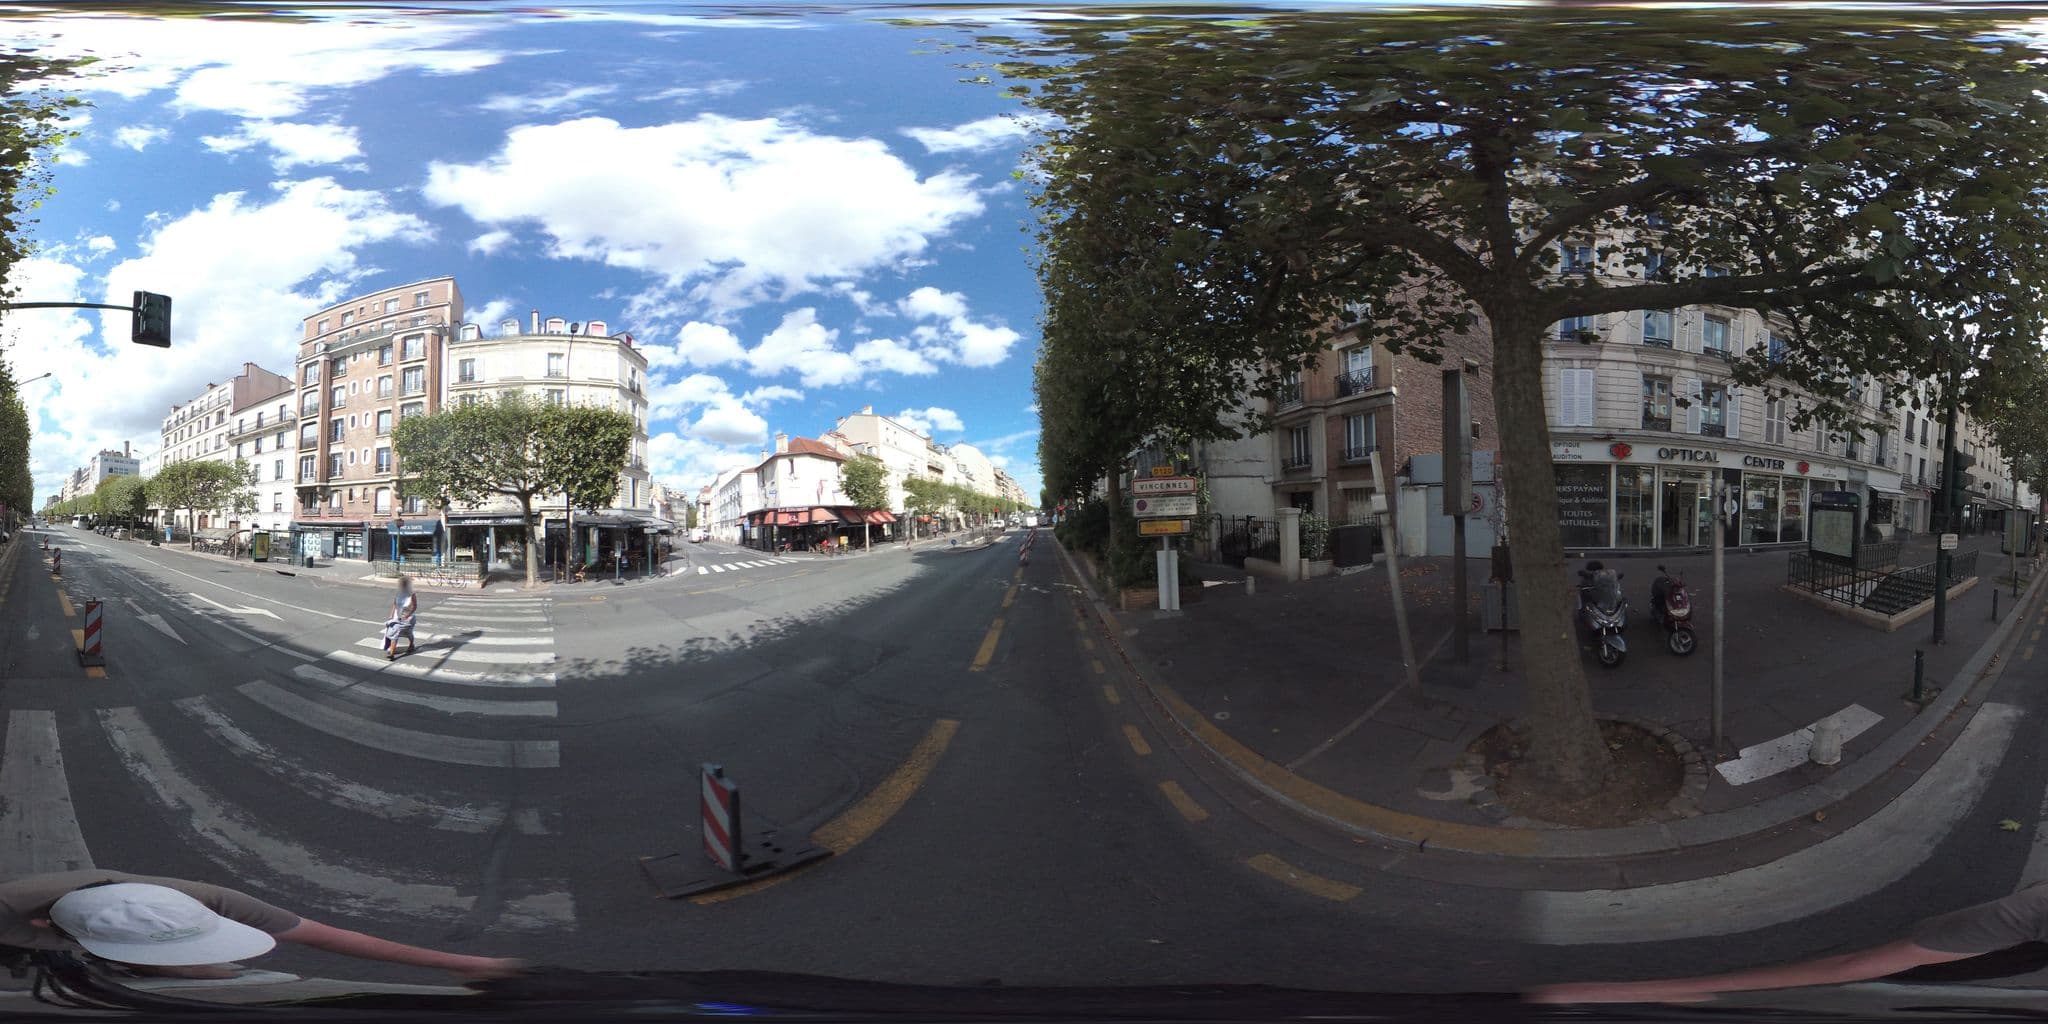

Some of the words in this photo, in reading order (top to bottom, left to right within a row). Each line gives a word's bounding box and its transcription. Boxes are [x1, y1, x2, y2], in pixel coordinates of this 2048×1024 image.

[1658, 447, 1720, 463] OPTICAL
[1743, 455, 1785, 470] CENTER
[1140, 482, 1188, 490] VINCENNES
[1563, 510, 1593, 518] TOUTES
